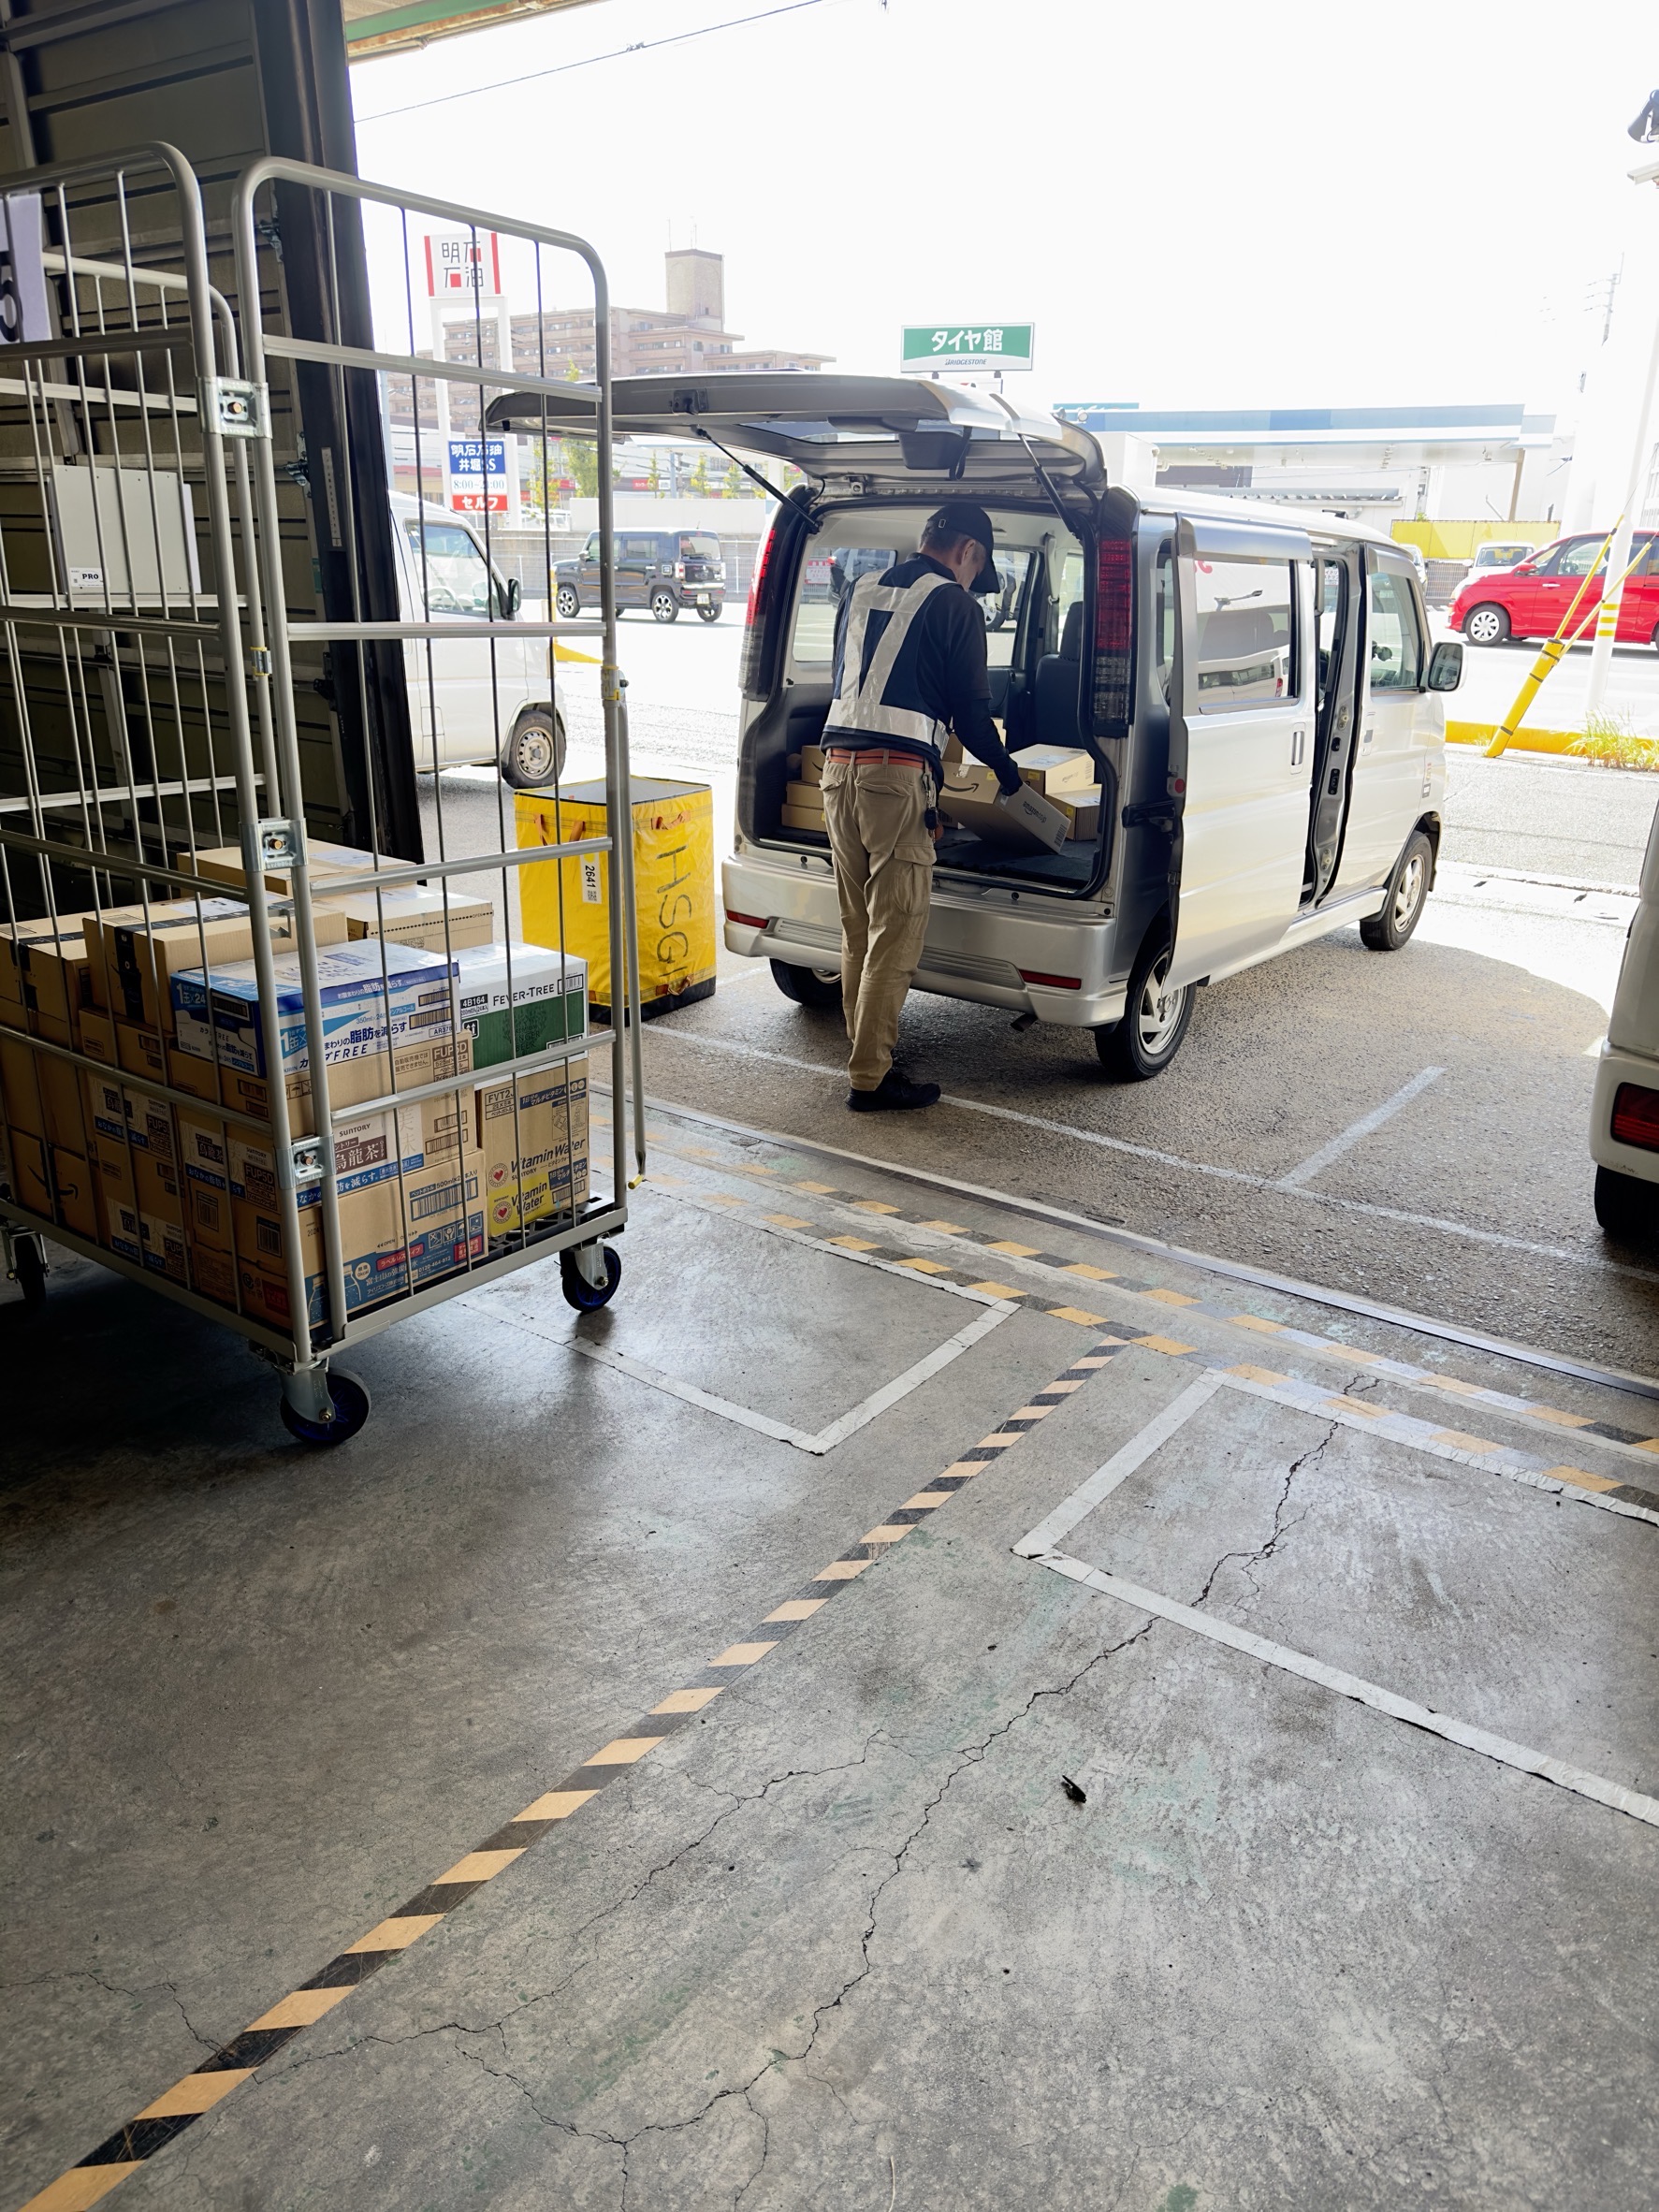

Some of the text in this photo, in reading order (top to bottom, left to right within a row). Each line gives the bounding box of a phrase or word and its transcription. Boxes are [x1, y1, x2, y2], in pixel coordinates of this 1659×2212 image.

[931, 328, 1003, 352] タイヤ館
[461, 496, 499, 510] セルフ
[585, 865, 596, 889] 2641
[462, 996, 486, 1008] 4B164
[148, 1116, 168, 1133] FUP5
[339, 1123, 371, 1137] SUNTORY
[245, 1164, 274, 1185] FUP5D
[511, 1183, 547, 1207] Vamin
[381, 1246, 421, 1267] ラベルレスイプ
